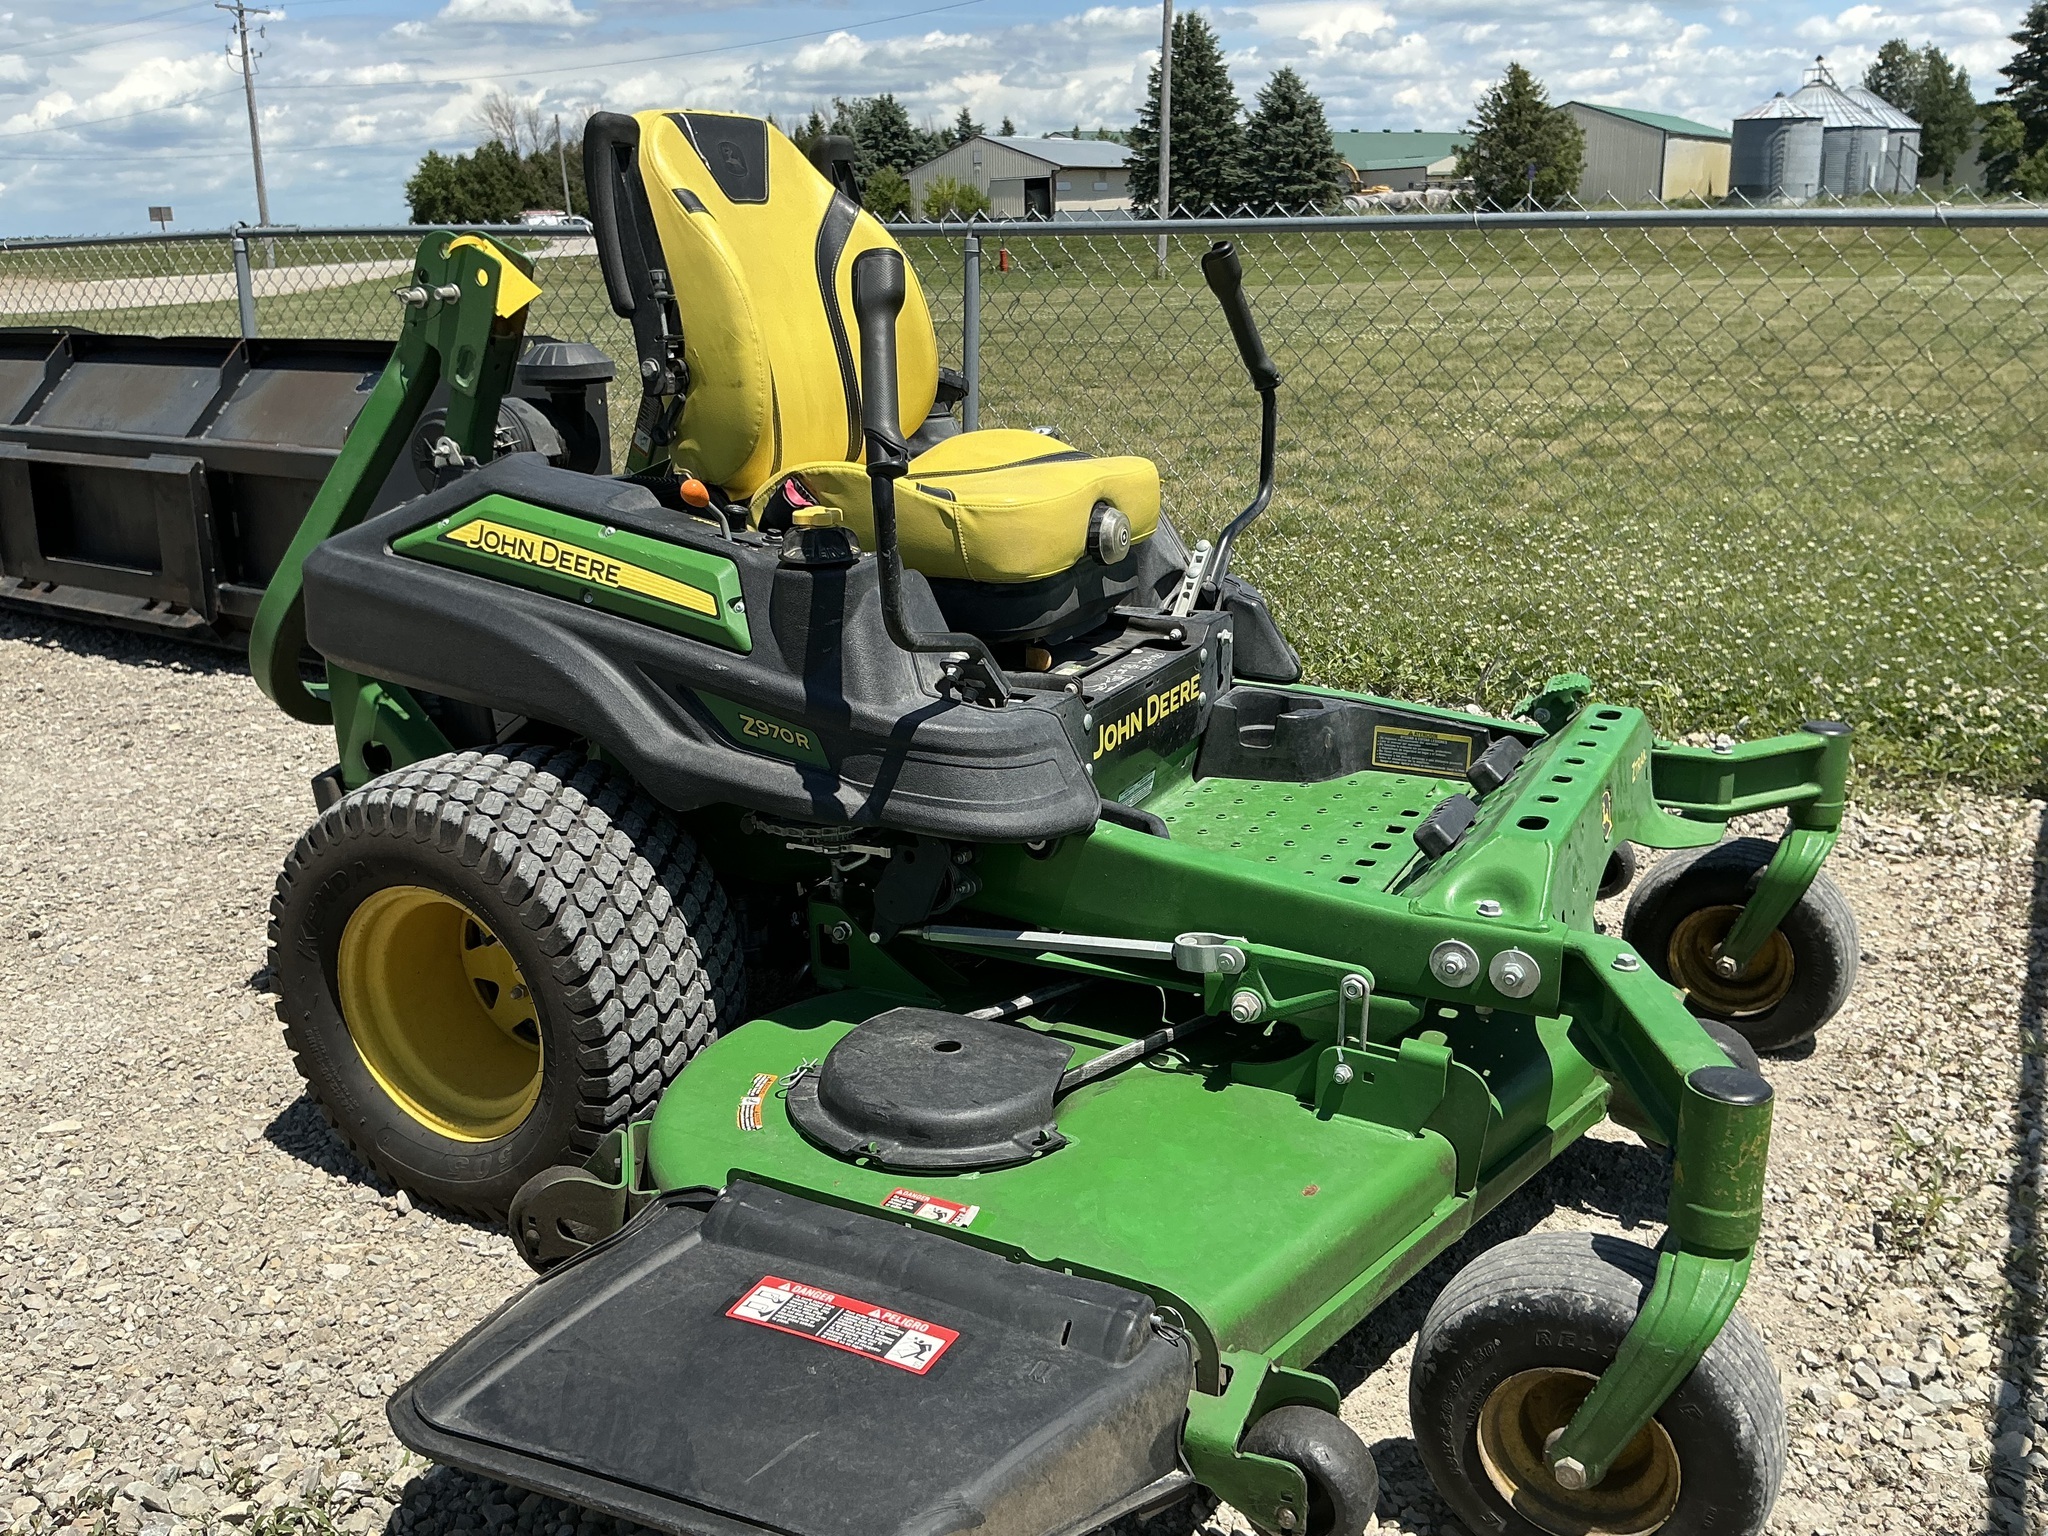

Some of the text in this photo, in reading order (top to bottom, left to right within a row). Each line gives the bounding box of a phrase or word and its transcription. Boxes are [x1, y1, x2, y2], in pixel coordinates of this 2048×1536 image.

[469, 524, 621, 585] JOHN DEERE
[739, 714, 811, 750] Z970R
[1093, 707, 1143, 760] JOHN
[1147, 673, 1200, 728] DEERE
[297, 860, 375, 962] KENDA
[902, 1190, 931, 1203] DANGER
[791, 1285, 835, 1303] DANGER
[881, 1311, 930, 1332] PELIGRO
